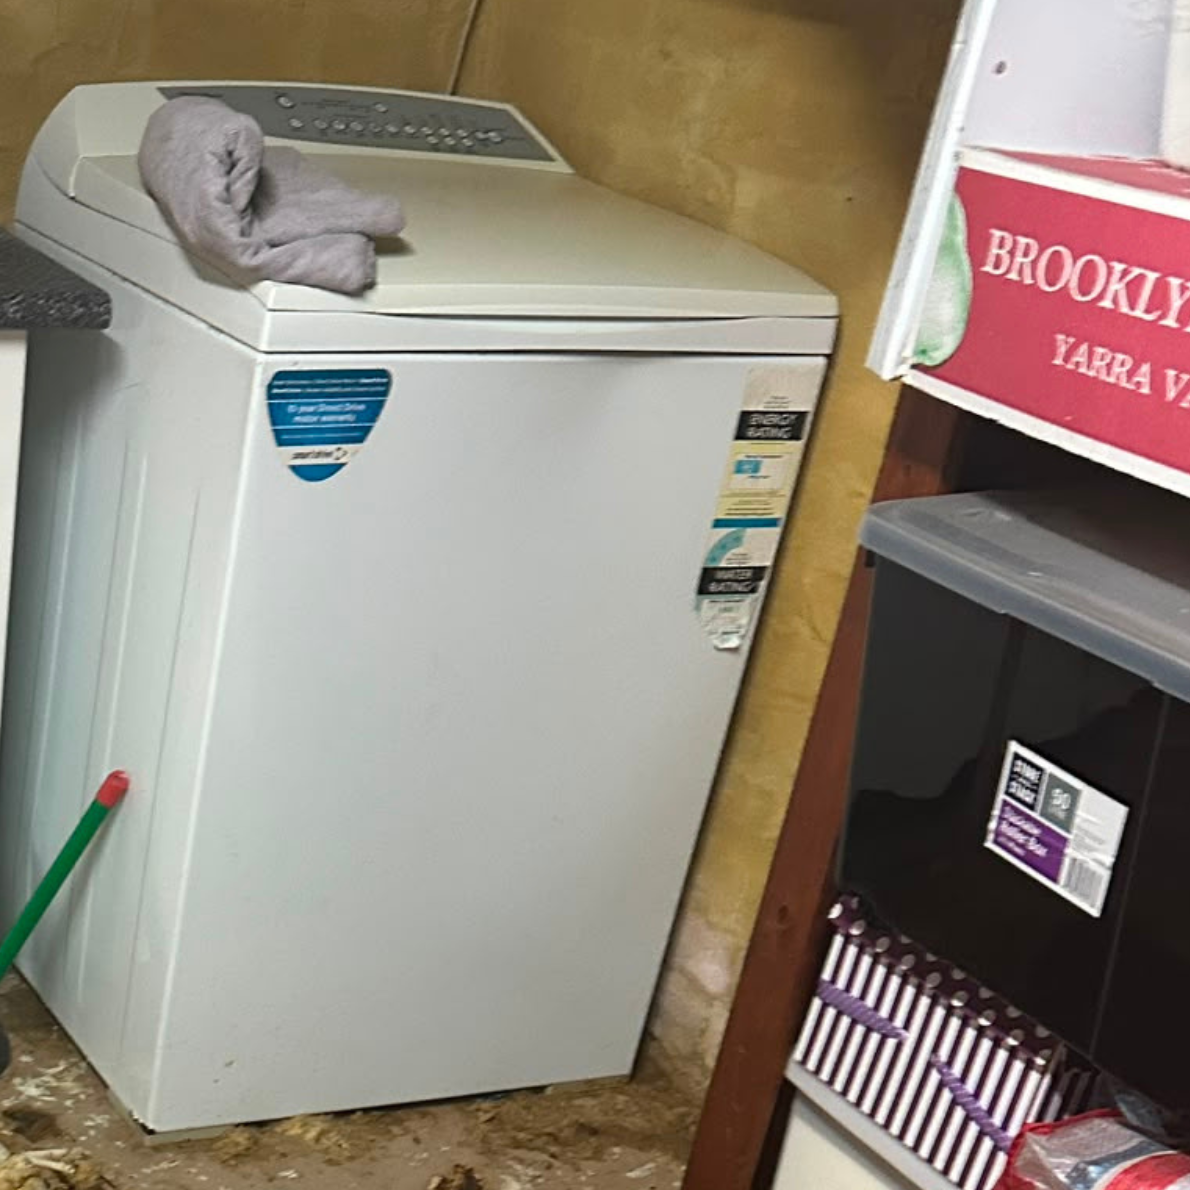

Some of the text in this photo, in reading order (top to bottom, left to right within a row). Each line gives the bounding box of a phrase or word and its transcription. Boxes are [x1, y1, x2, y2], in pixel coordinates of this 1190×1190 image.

[980, 228, 1190, 333] BROOKLY
[1051, 333, 1152, 395] YARRA
[746, 427, 792, 438] RATING
[749, 414, 798, 425] ENERGY
